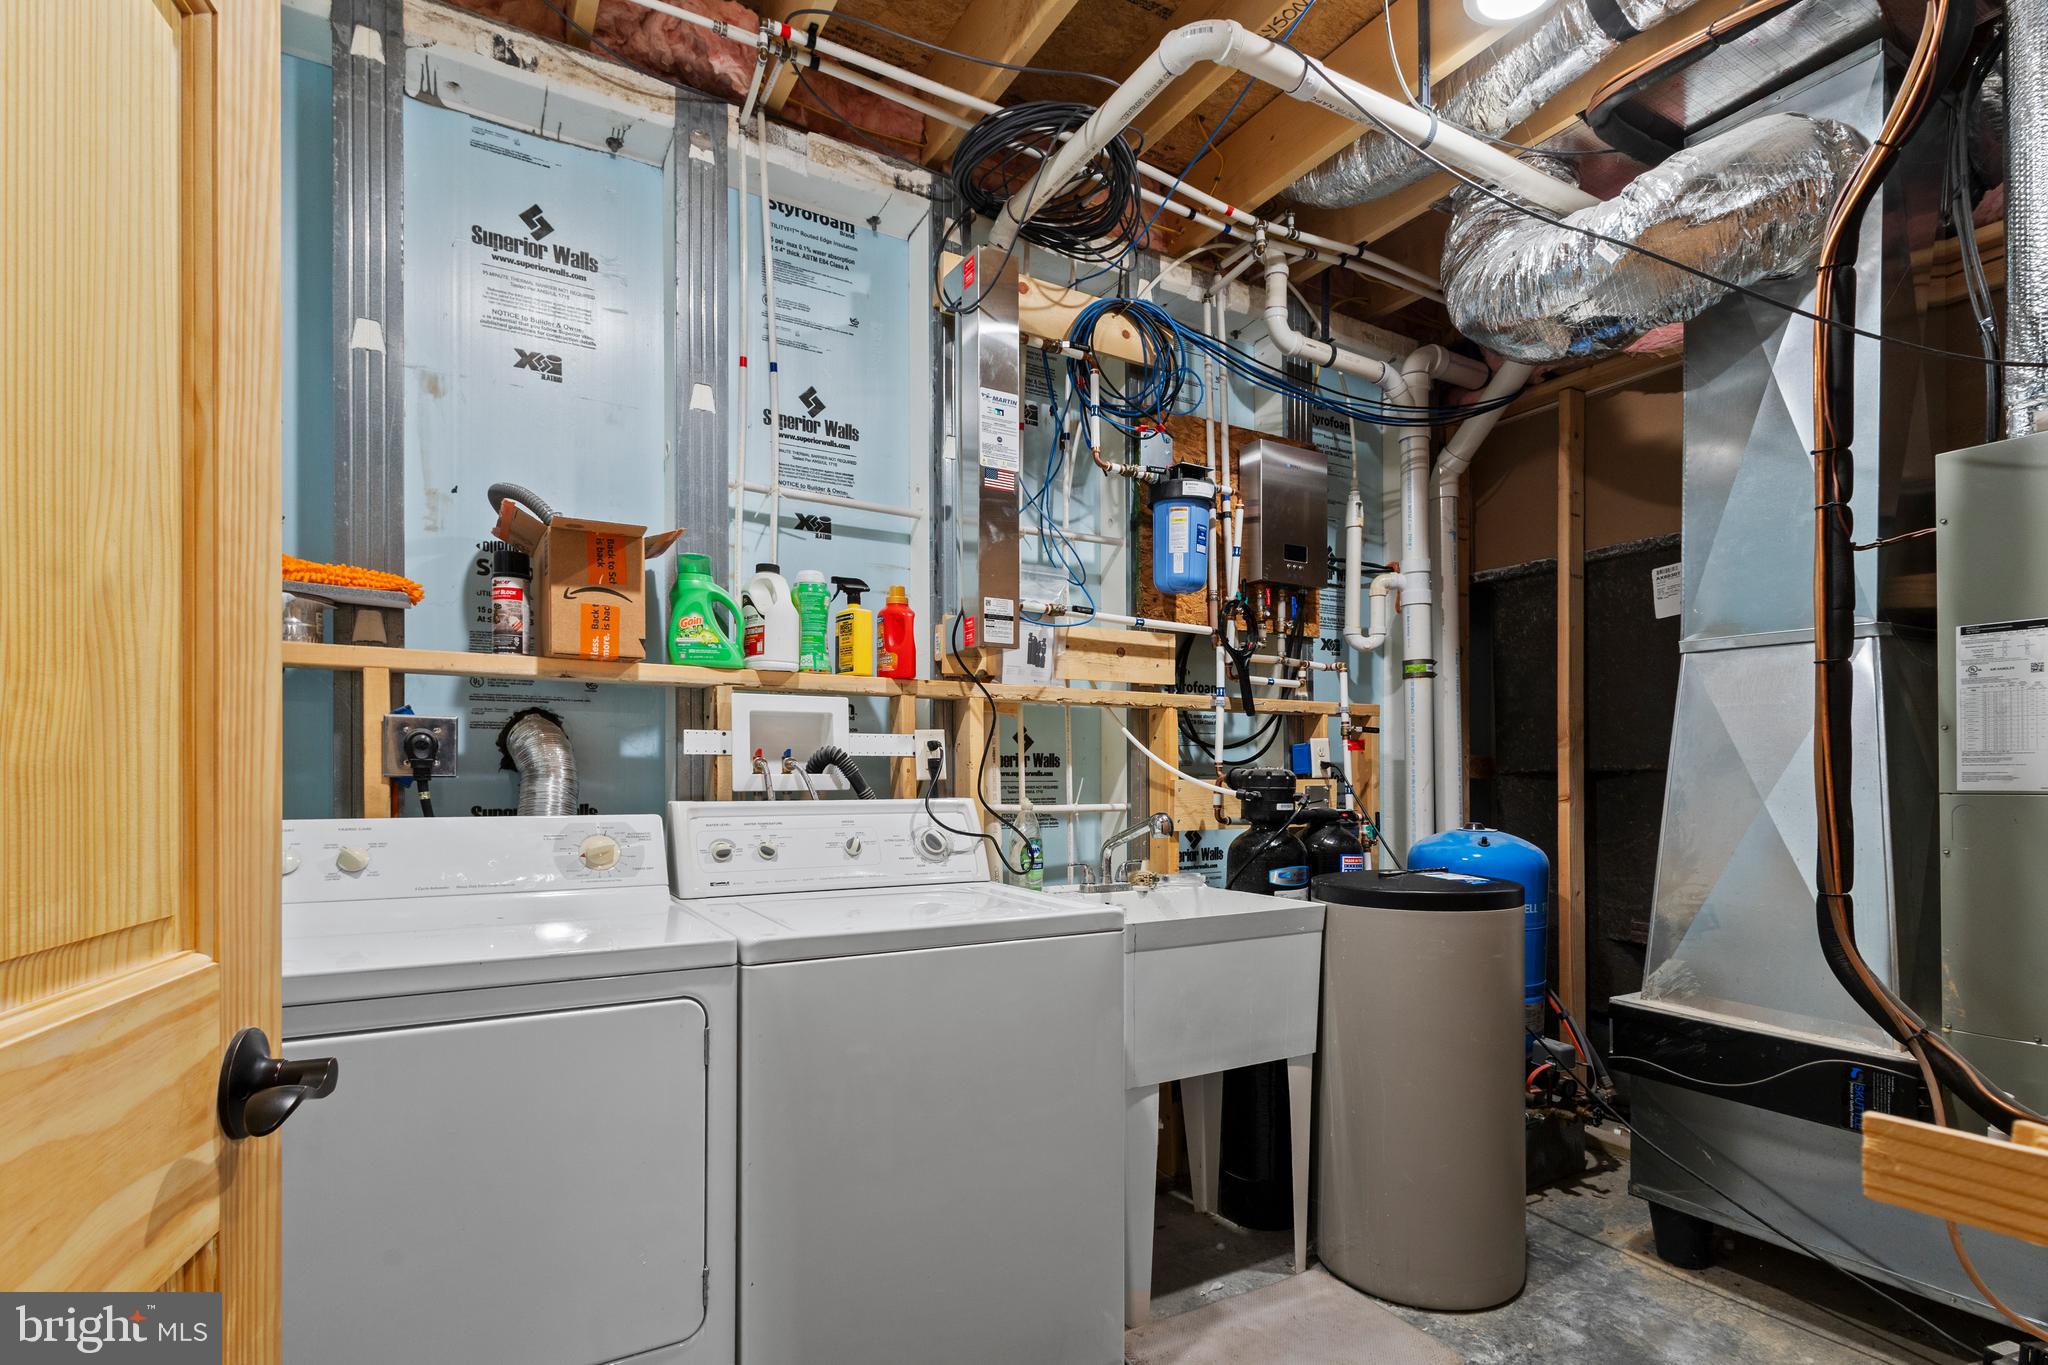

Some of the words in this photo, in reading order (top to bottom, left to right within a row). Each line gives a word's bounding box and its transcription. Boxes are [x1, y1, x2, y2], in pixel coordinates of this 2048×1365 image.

[1258, 0, 1308, 39] YSON
[471, 224, 548, 260] Superior
[553, 244, 599, 273] Walls
[819, 237, 832, 245] Edge
[801, 253, 818, 262] ASTM
[829, 261, 844, 270] Class
[812, 249, 827, 257] water
[827, 251, 855, 265] absorption
[491, 253, 587, 282] www.superiorwalls.com
[491, 309, 520, 321] NOTICE
[992, 396, 1018, 406] MARTIN
[762, 408, 821, 434] Sperior
[824, 419, 860, 442] Walls
[778, 480, 800, 488] NOTICE
[806, 484, 826, 492] Builder
[591, 610, 600, 630] Back
[602, 606, 611, 622] bac
[680, 616, 704, 629] Gain
[602, 633, 611, 657] more.
[1033, 752, 1060, 768] Walls
[1201, 847, 1224, 861] Walls
